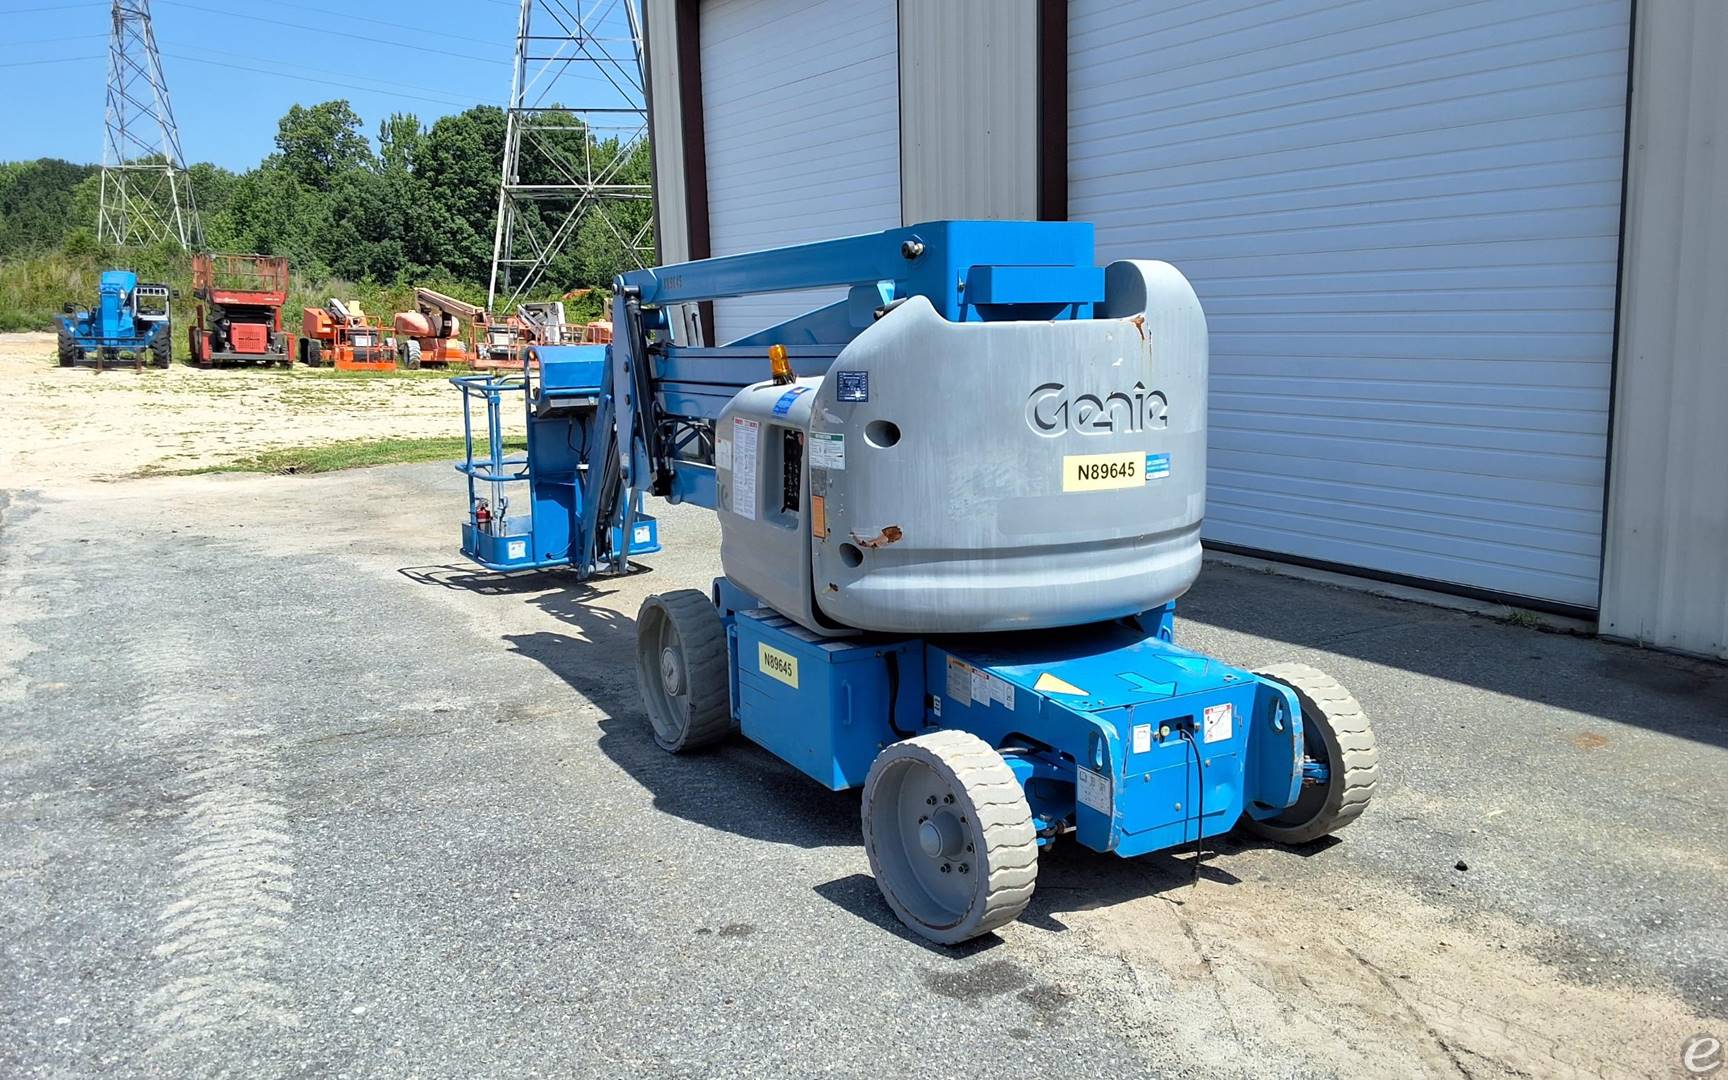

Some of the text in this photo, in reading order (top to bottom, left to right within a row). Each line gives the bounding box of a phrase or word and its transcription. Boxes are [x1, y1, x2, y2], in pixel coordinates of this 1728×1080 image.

[1025, 381, 1168, 438] Genie
[1078, 461, 1135, 481] N89645
[764, 651, 793, 677] N89645
